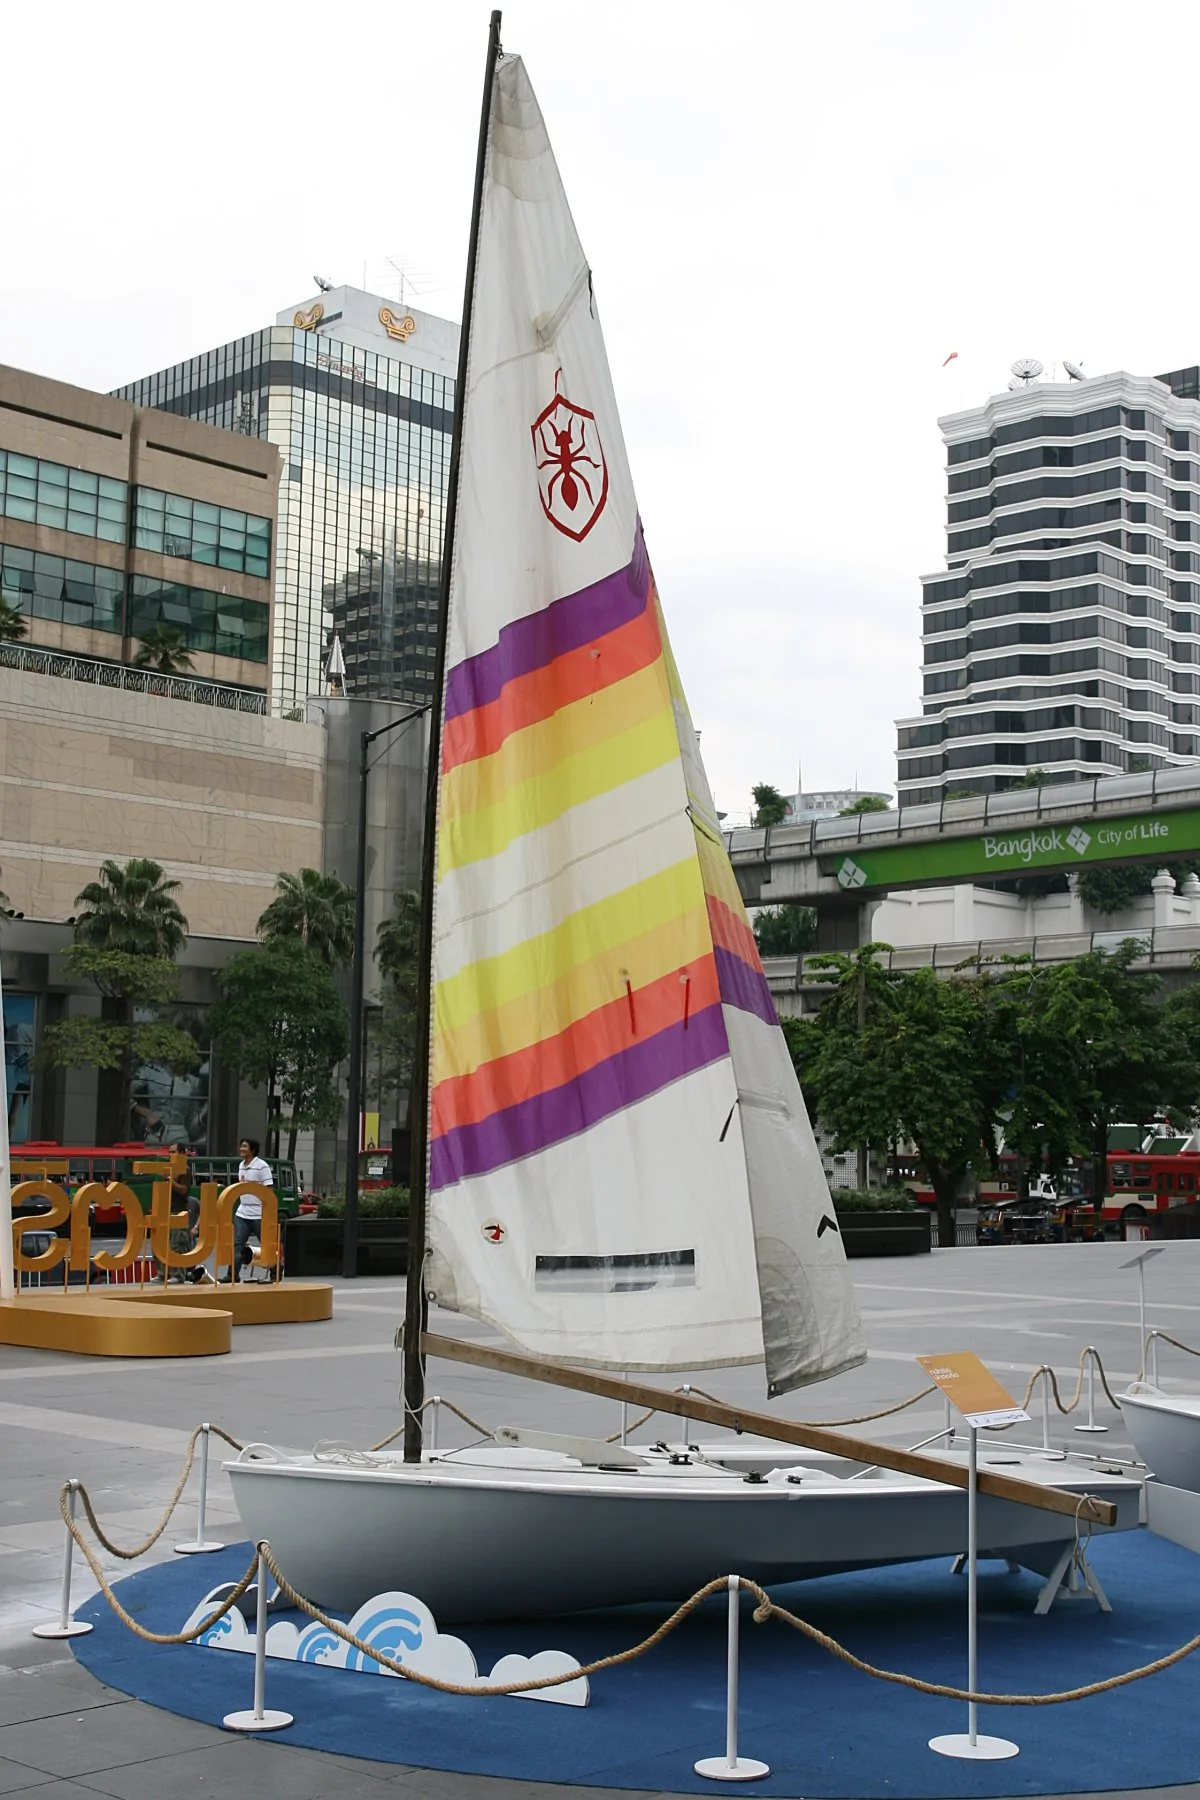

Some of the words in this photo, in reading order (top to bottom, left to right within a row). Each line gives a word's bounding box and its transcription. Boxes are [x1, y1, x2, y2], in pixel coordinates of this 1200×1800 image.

[983, 830, 1065, 862] Bangkok
[1097, 828, 1122, 846] City
[1125, 825, 1138, 841] of
[1140, 821, 1169, 839] Life
